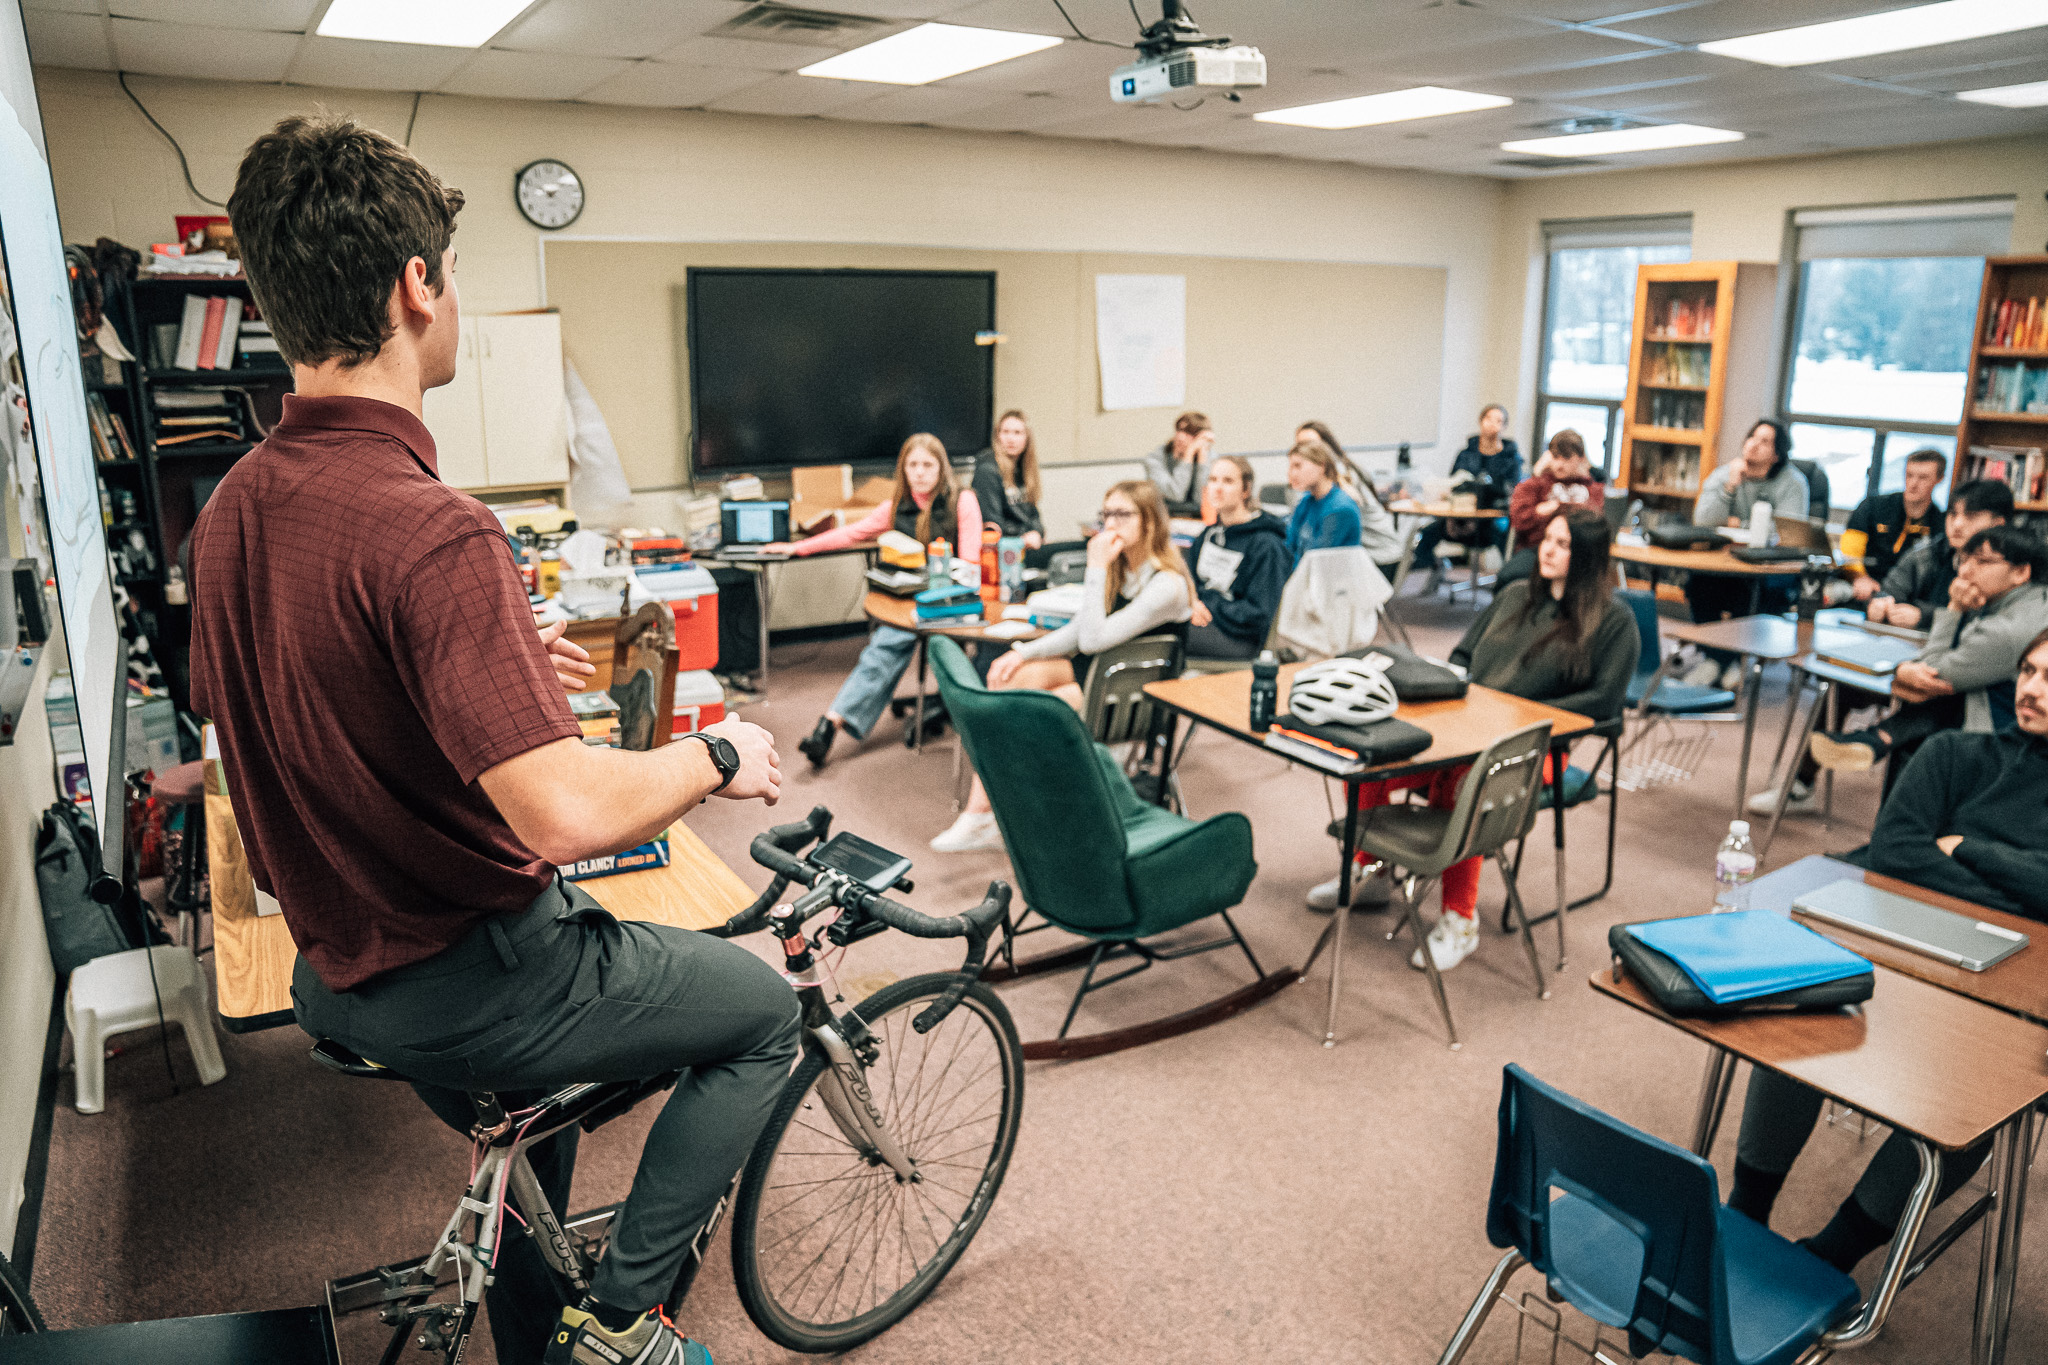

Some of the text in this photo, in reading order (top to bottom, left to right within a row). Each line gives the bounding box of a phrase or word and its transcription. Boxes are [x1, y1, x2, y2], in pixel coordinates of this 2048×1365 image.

[577, 856, 616, 874] CLANCY
[617, 855, 645, 867] LOCKED
[646, 853, 657, 863] ON
[537, 1211, 586, 1290] FUJI
